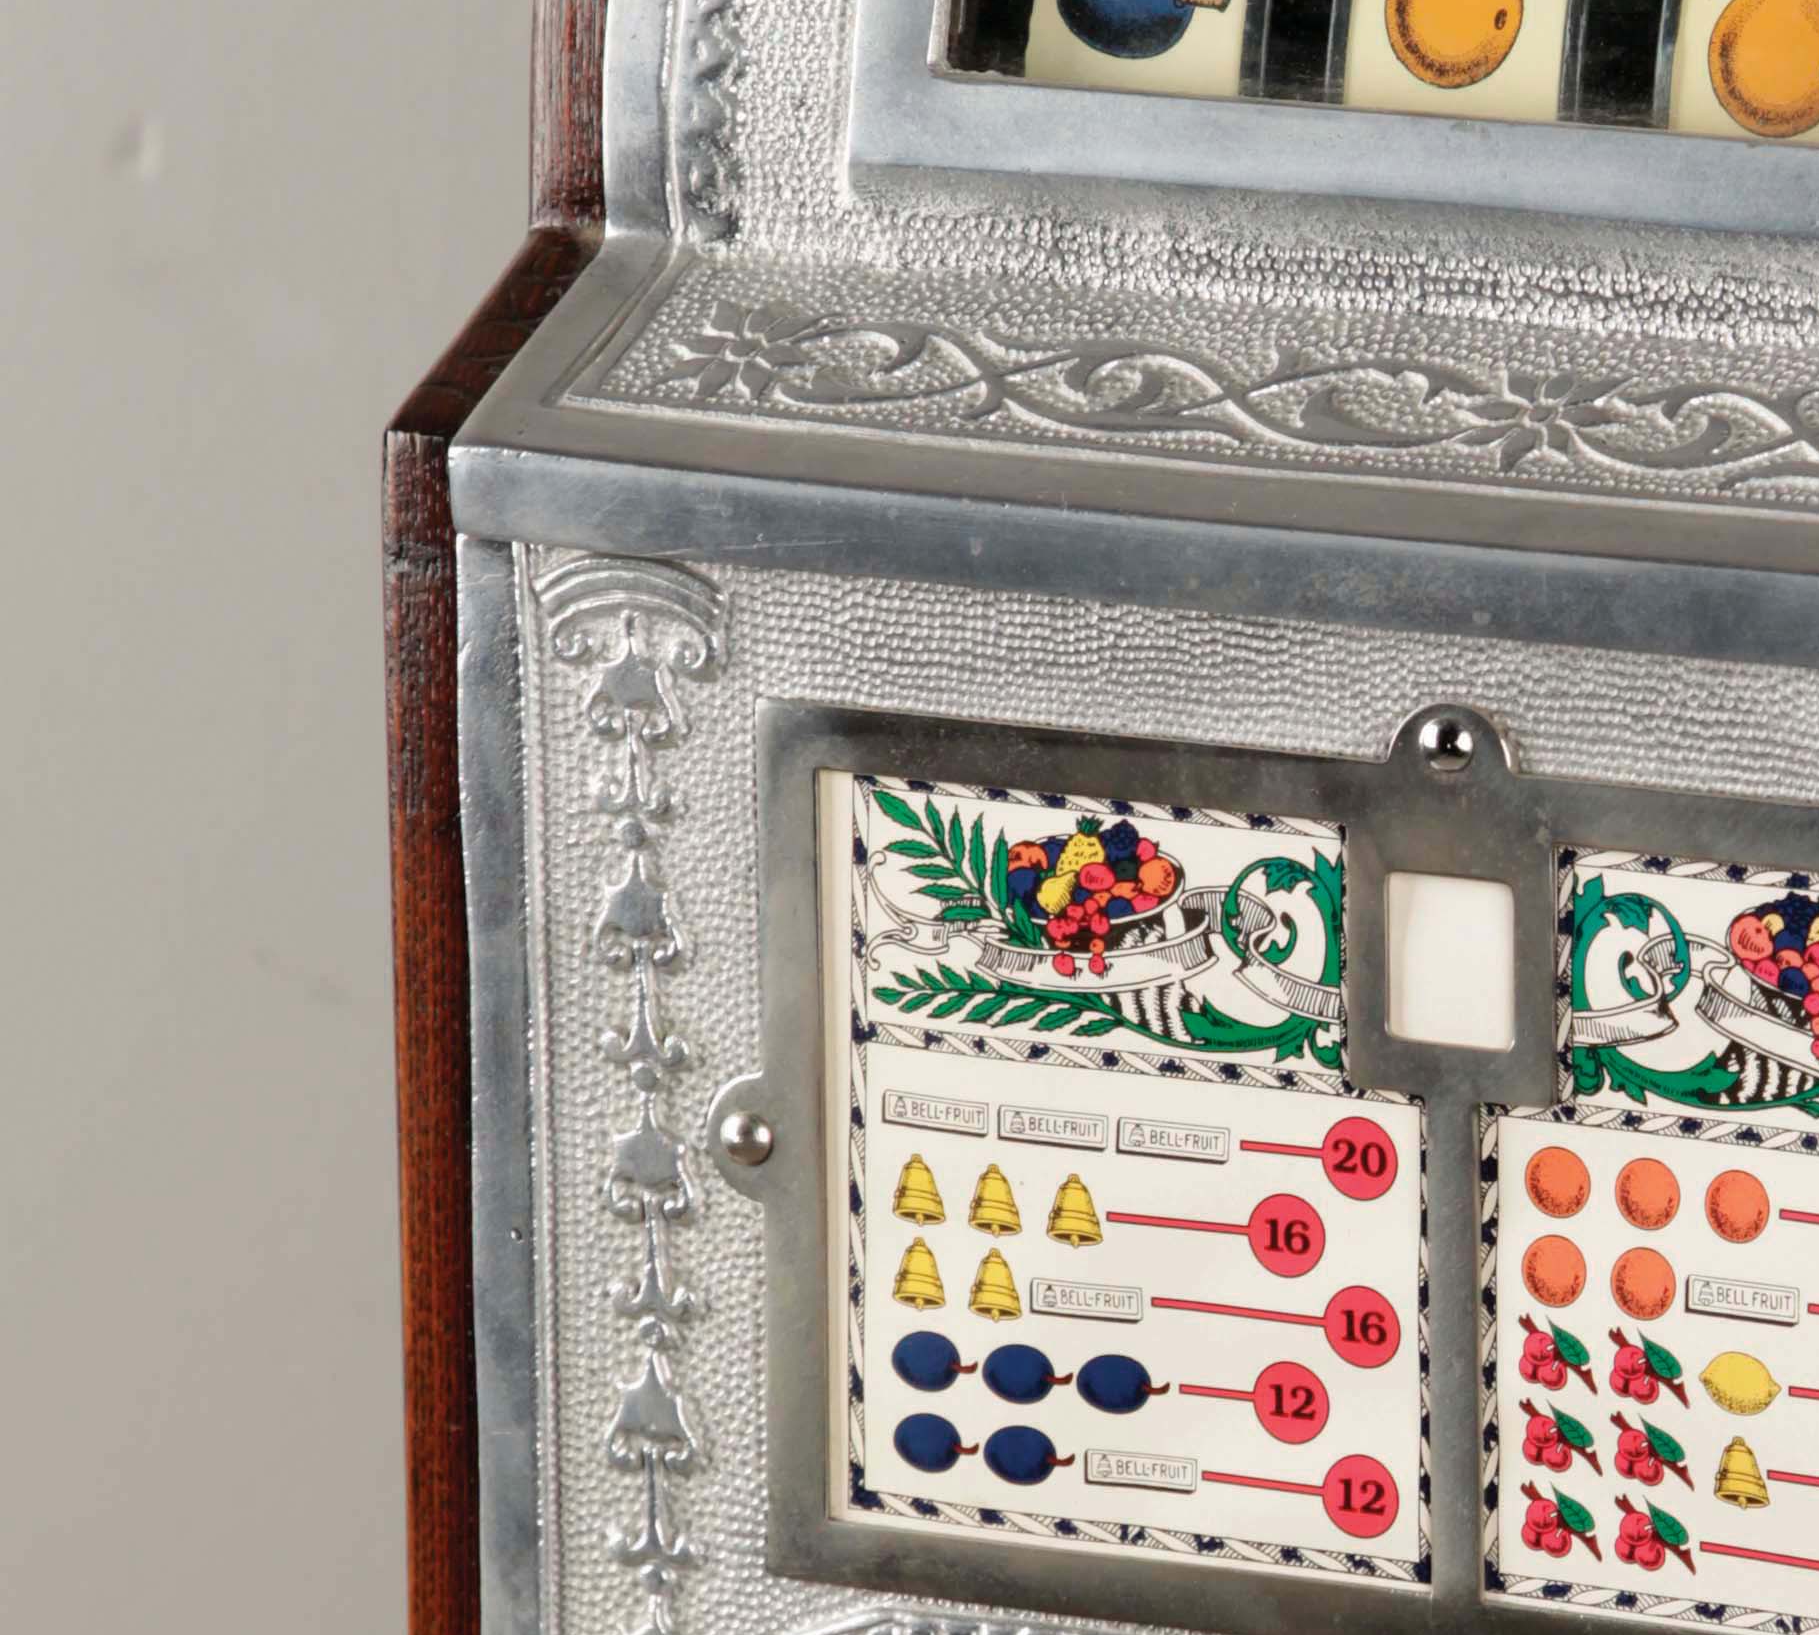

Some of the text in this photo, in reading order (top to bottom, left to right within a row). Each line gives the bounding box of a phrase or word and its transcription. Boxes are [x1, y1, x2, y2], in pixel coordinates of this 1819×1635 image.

[911, 1101, 1388, 1177] BELL-FRUIT BELL-FRUIT BELL-FRUIT 20
[1263, 1218, 1311, 1255] 16
[1060, 1288, 1388, 1346] BELL-FRUIT 16
[1268, 1383, 1317, 1421] 12
[1115, 1458, 1387, 1516] BELL-FRUIT 12
